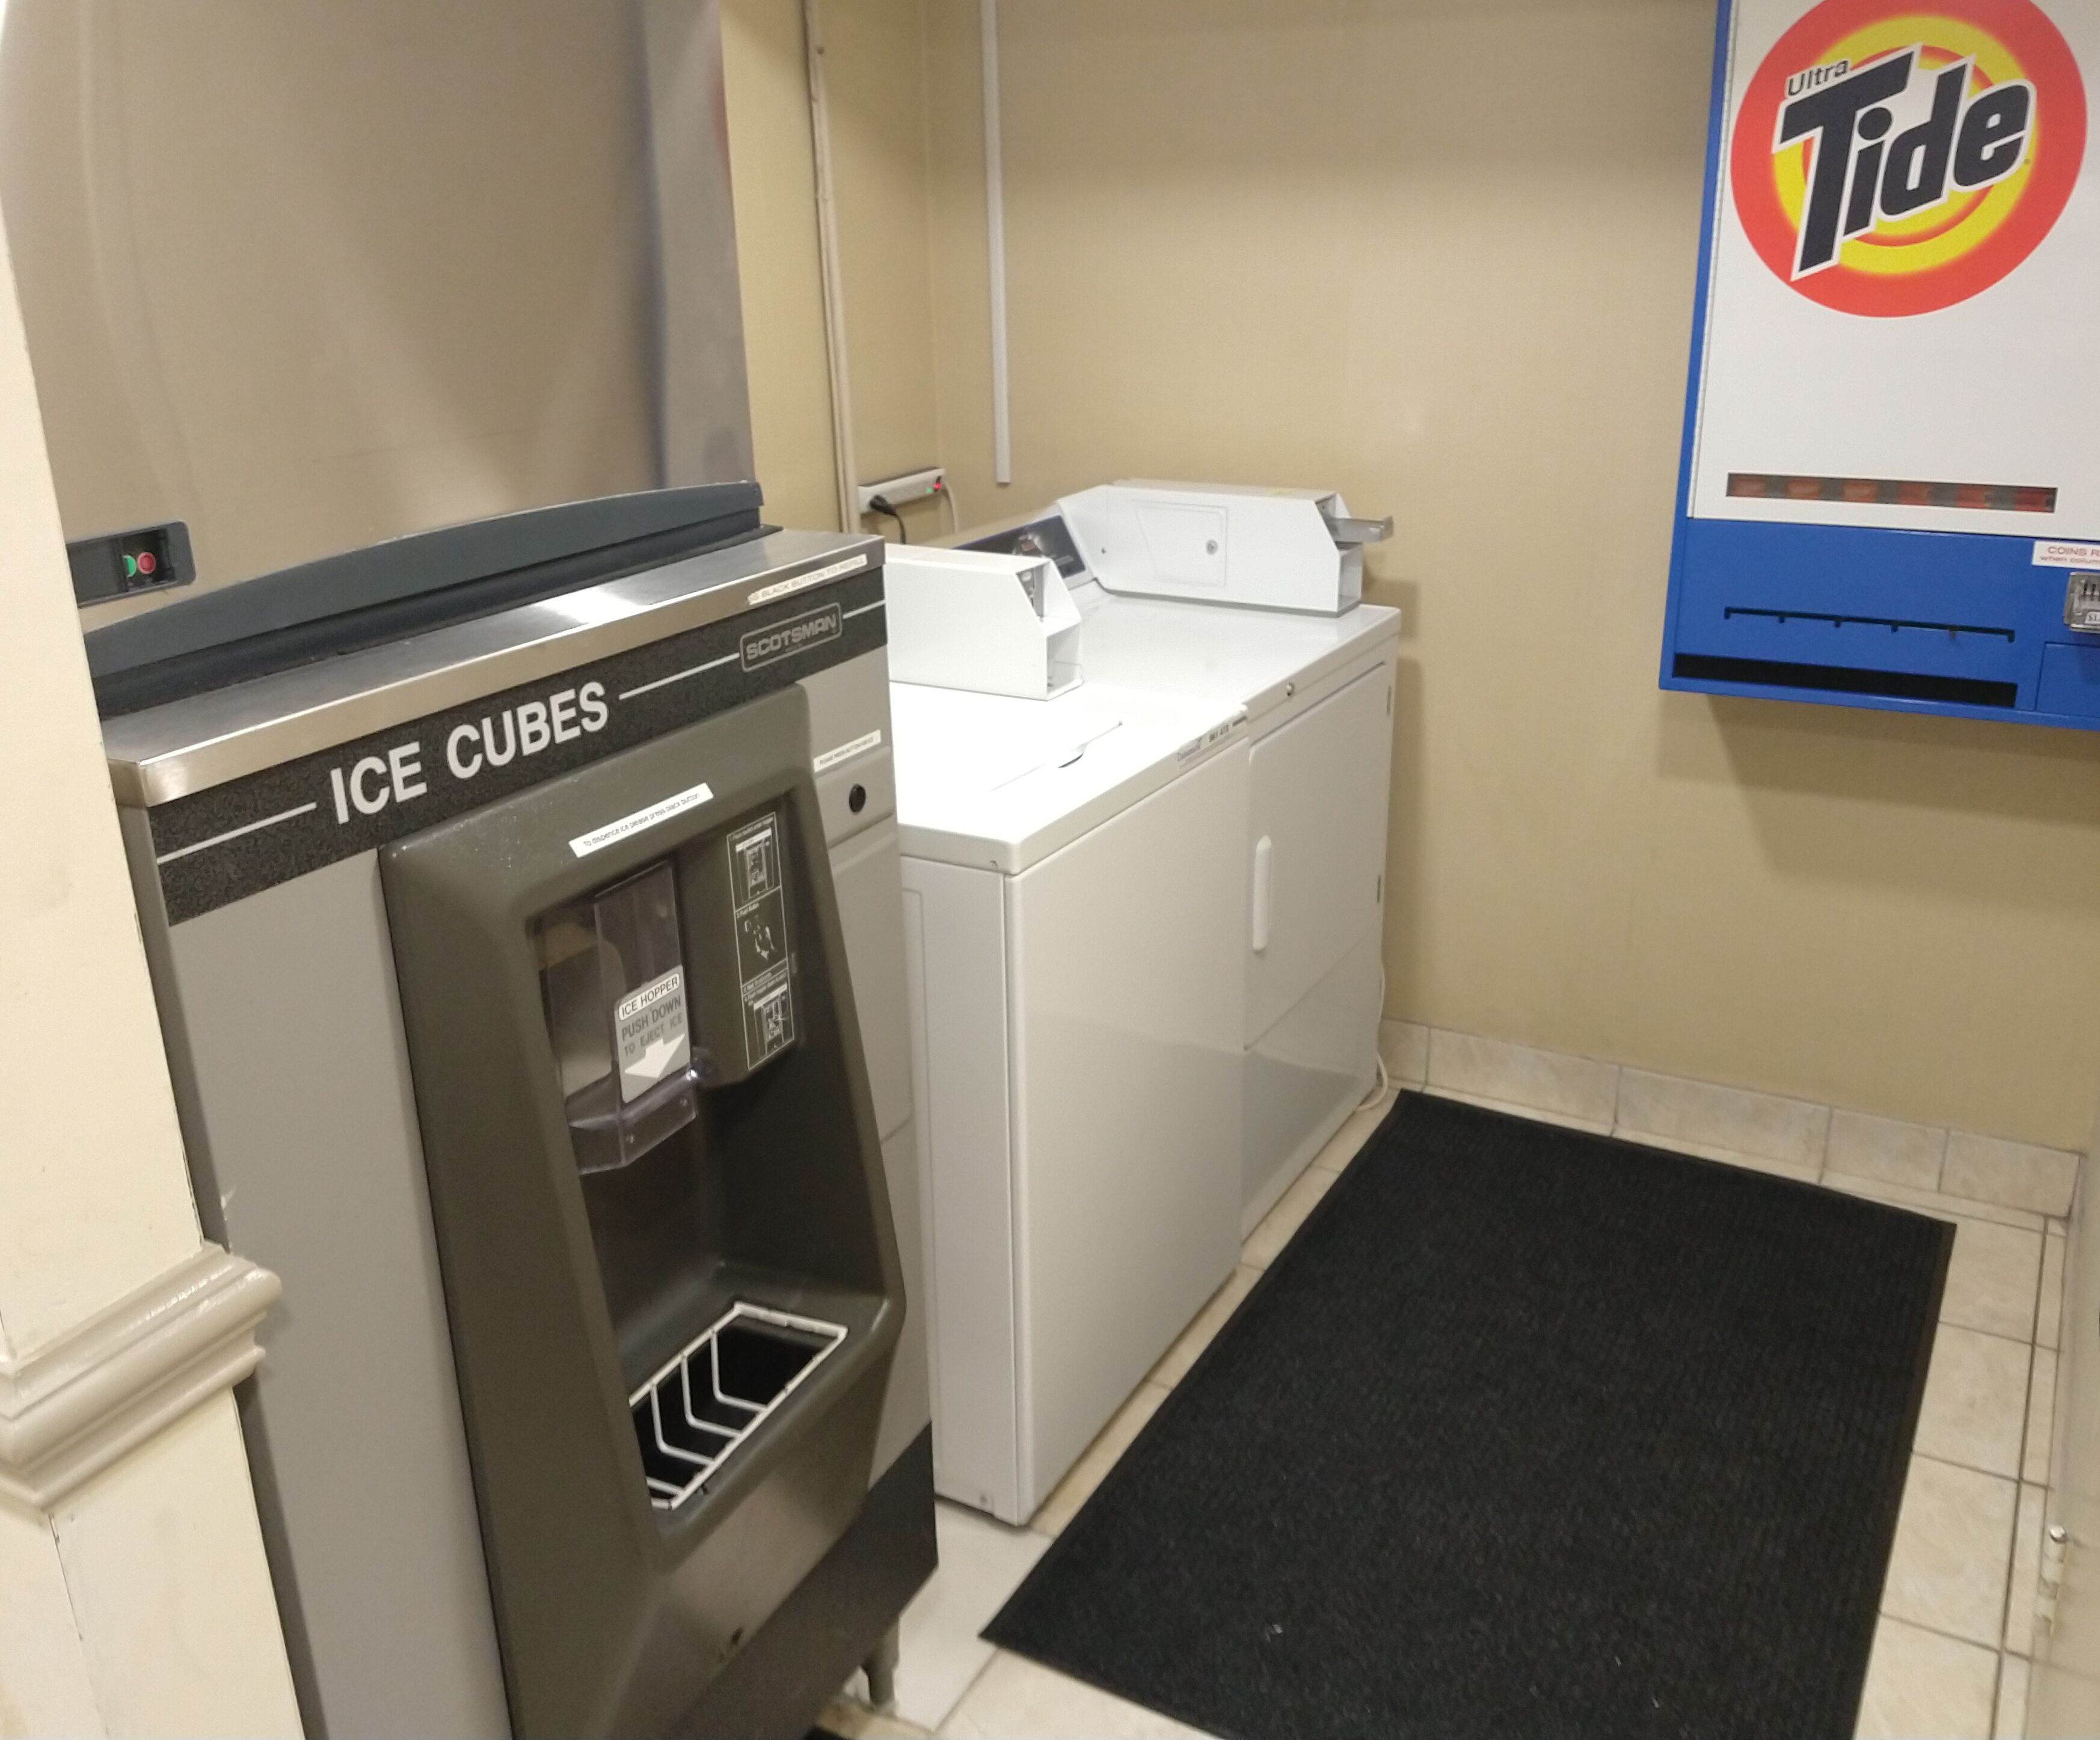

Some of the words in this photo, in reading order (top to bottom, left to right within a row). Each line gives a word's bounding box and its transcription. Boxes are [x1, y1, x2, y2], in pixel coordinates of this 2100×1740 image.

[1788, 60, 1849, 96] Ultra
[1778, 50, 2032, 273] Tide
[2047, 546, 2087, 556] COINS
[761, 584, 790, 598] BLACK
[792, 572, 824, 588] BUTTON
[826, 566, 838, 576] TO
[746, 613, 837, 660] SCOTSMAN
[330, 741, 428, 825] ICE
[447, 681, 608, 779] CUBES
[620, 824, 629, 832] ice
[629, 815, 649, 829] please
[649, 807, 666, 821] press
[666, 801, 680, 812] black
[681, 792, 700, 805] button
[622, 999, 638, 1018] ICE
[640, 976, 678, 1006] HOPPER
[622, 1014, 649, 1041] PUSH
[651, 995, 681, 1023] DOWN
[624, 1042, 635, 1056] TO
[640, 1024, 665, 1047] EJECT
[669, 1012, 683, 1029] ICE
